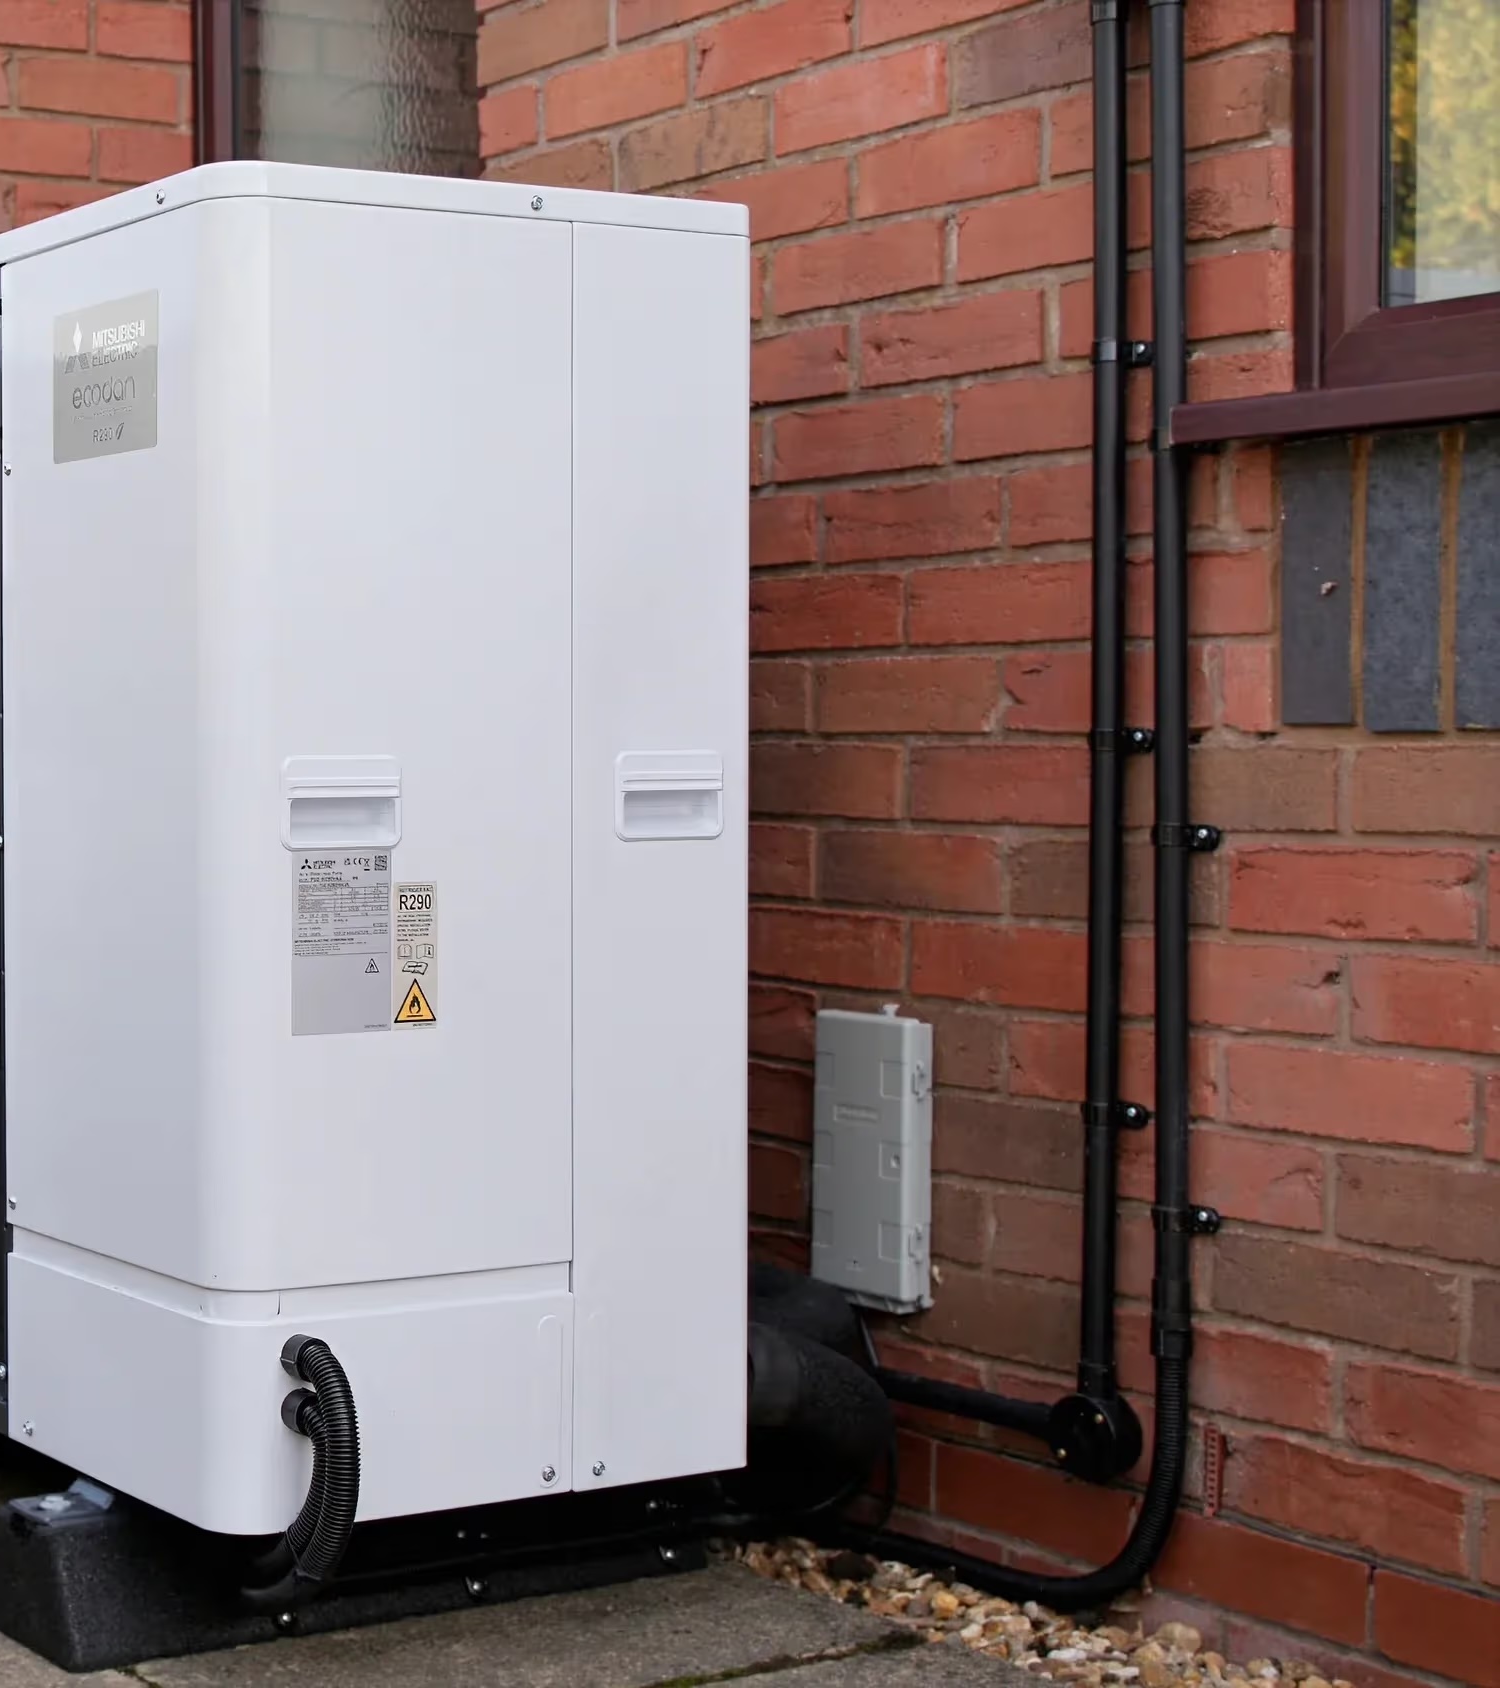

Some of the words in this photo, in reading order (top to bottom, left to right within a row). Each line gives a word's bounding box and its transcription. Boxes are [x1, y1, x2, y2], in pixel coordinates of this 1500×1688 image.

[92, 319, 145, 348] MITSUBISHI
[91, 341, 139, 367] ELECTRIC
[72, 375, 136, 410] ecodan
[399, 894, 432, 910] R290
